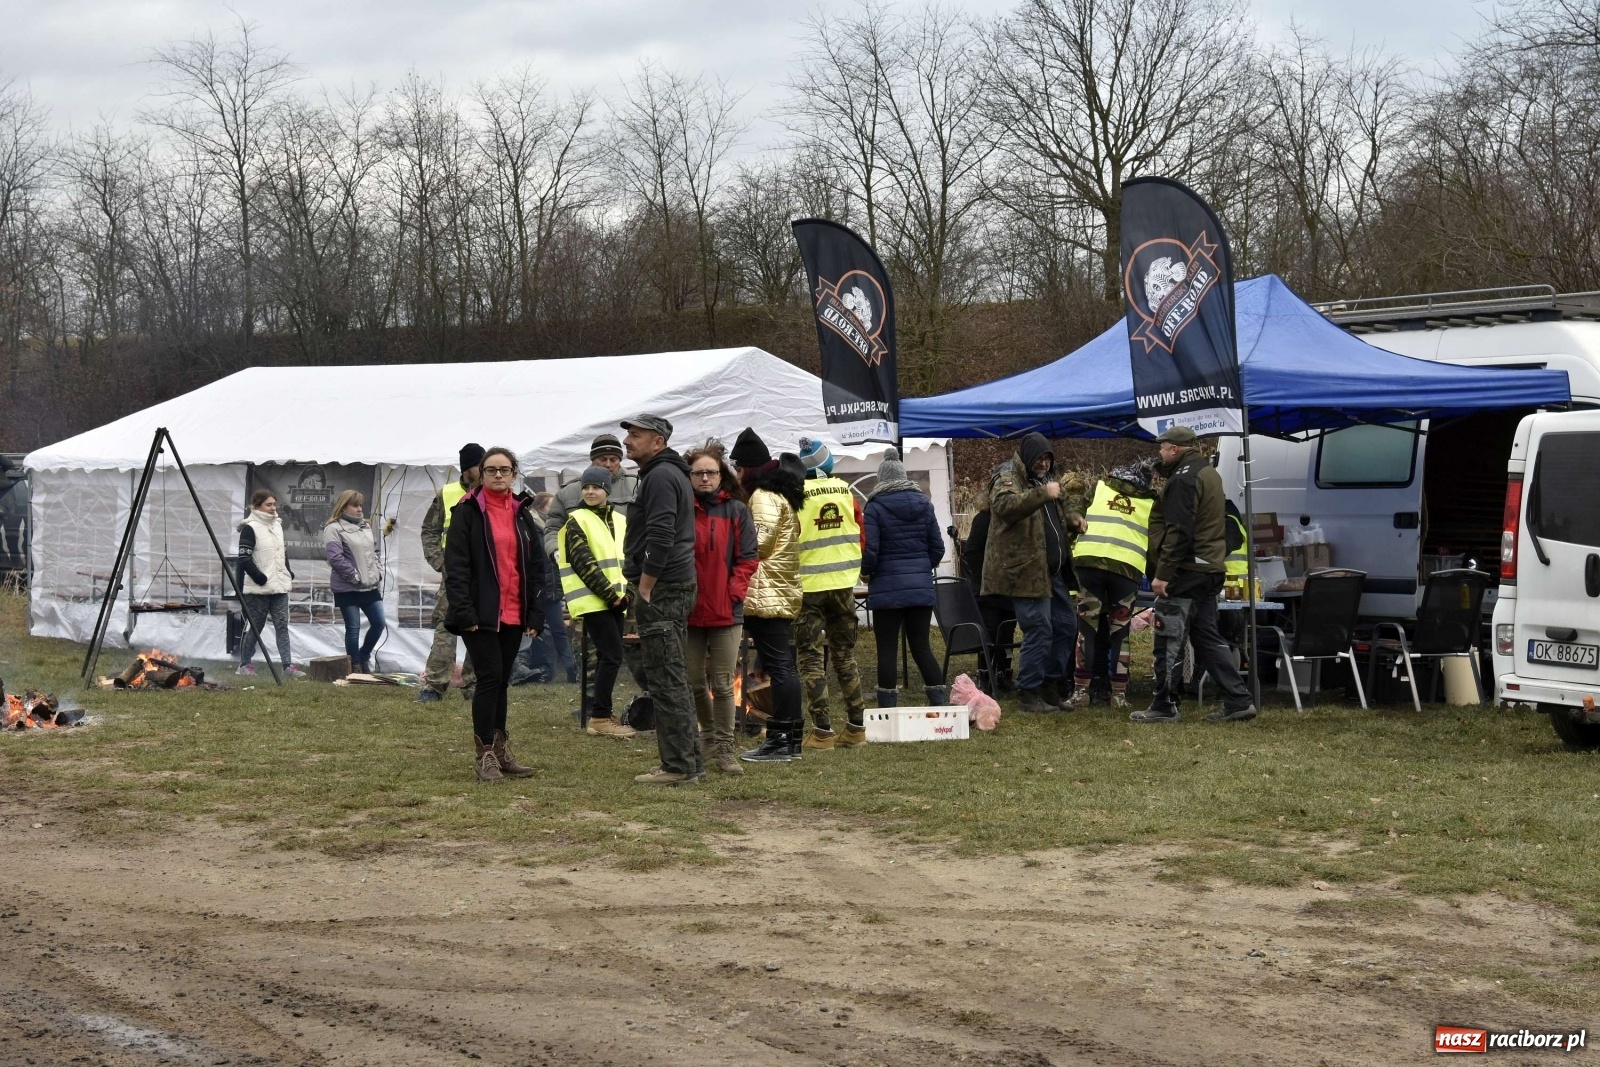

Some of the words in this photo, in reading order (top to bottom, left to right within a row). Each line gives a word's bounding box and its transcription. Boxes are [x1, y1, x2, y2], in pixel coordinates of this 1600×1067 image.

[1155, 282, 1189, 329] RACIBORSKI
[1186, 260, 1200, 283] KLUB
[1163, 270, 1208, 338] OFF-ROAD
[1136, 385, 1235, 410] WWW.SRC4X4.PL
[1189, 420, 1225, 432] cebook'u
[805, 486, 850, 499] RGANIZATOR
[1536, 643, 1553, 660] OK
[1557, 645, 1595, 664] 88675
